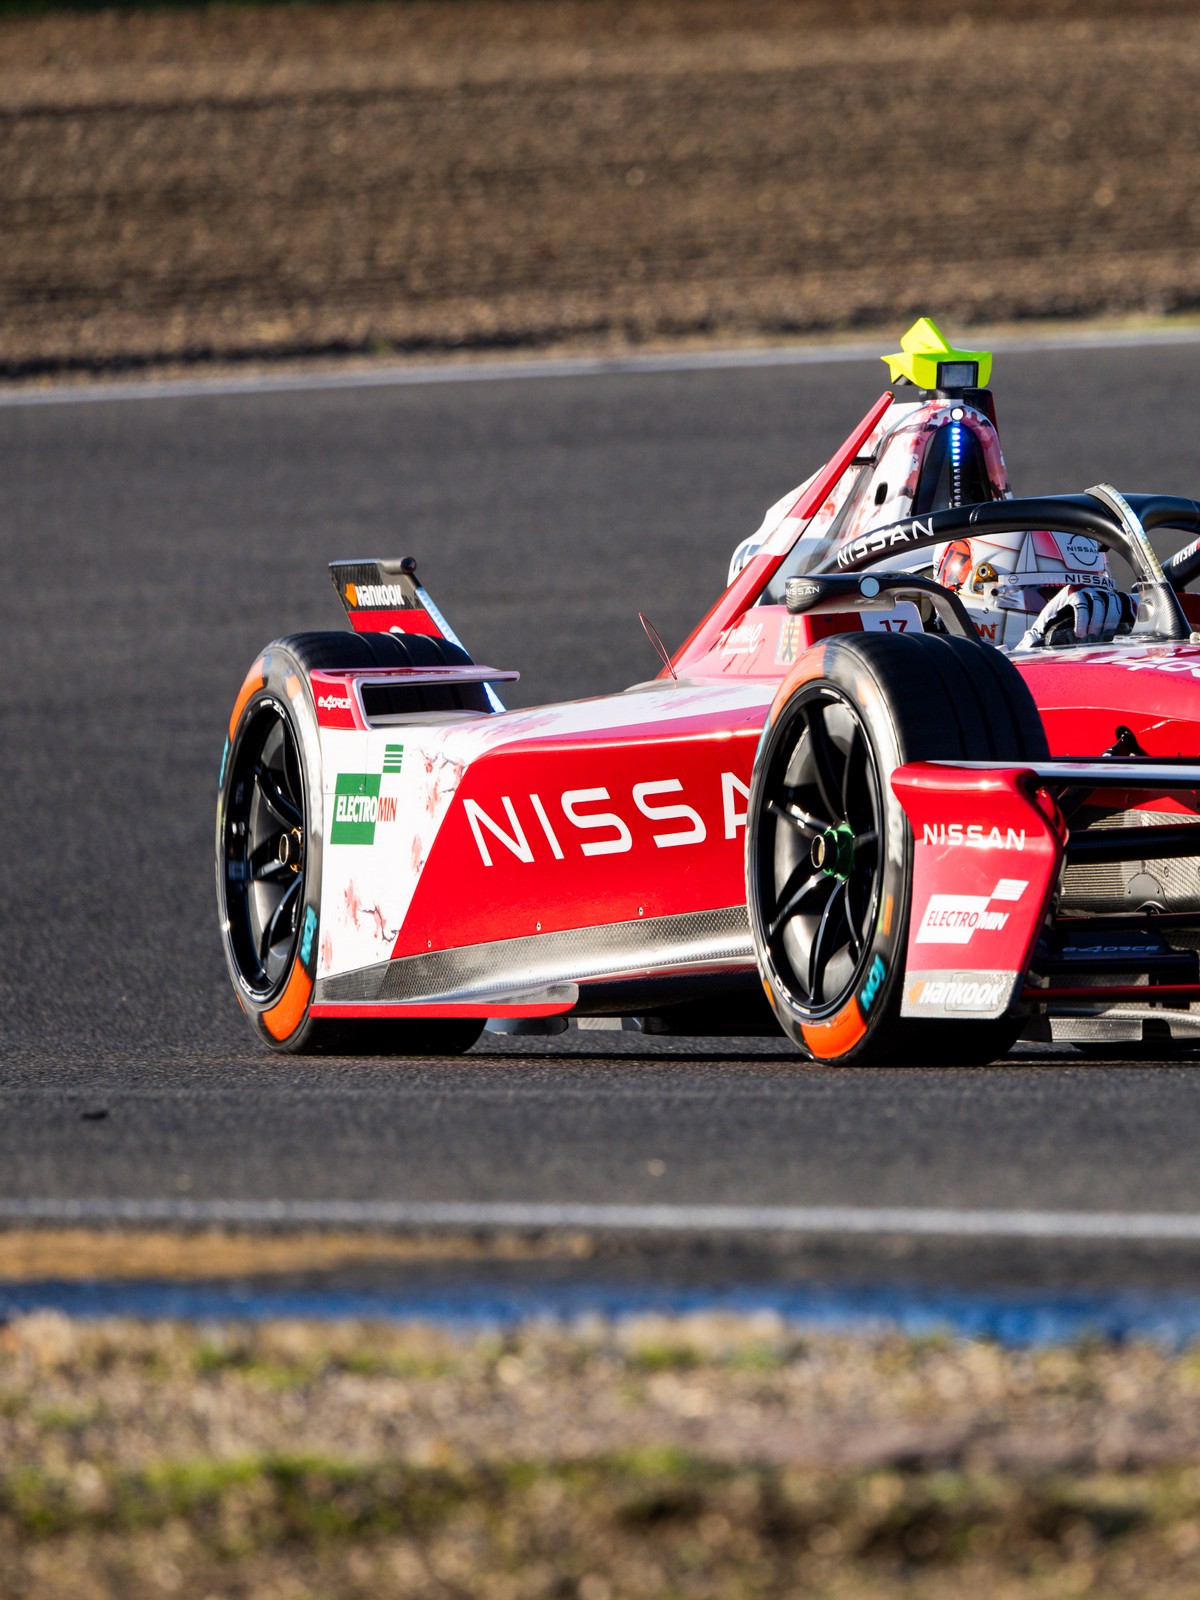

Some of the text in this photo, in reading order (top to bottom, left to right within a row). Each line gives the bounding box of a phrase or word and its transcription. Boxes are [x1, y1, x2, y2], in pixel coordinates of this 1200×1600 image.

[837, 517, 935, 569] NISSAN
[786, 585, 820, 596] NISSAN
[1064, 574, 1115, 588] NISSAN
[335, 795, 398, 823] ELECTROMIN
[923, 823, 1025, 851] NISSAN
[926, 910, 1010, 931] ELECTROMIN
